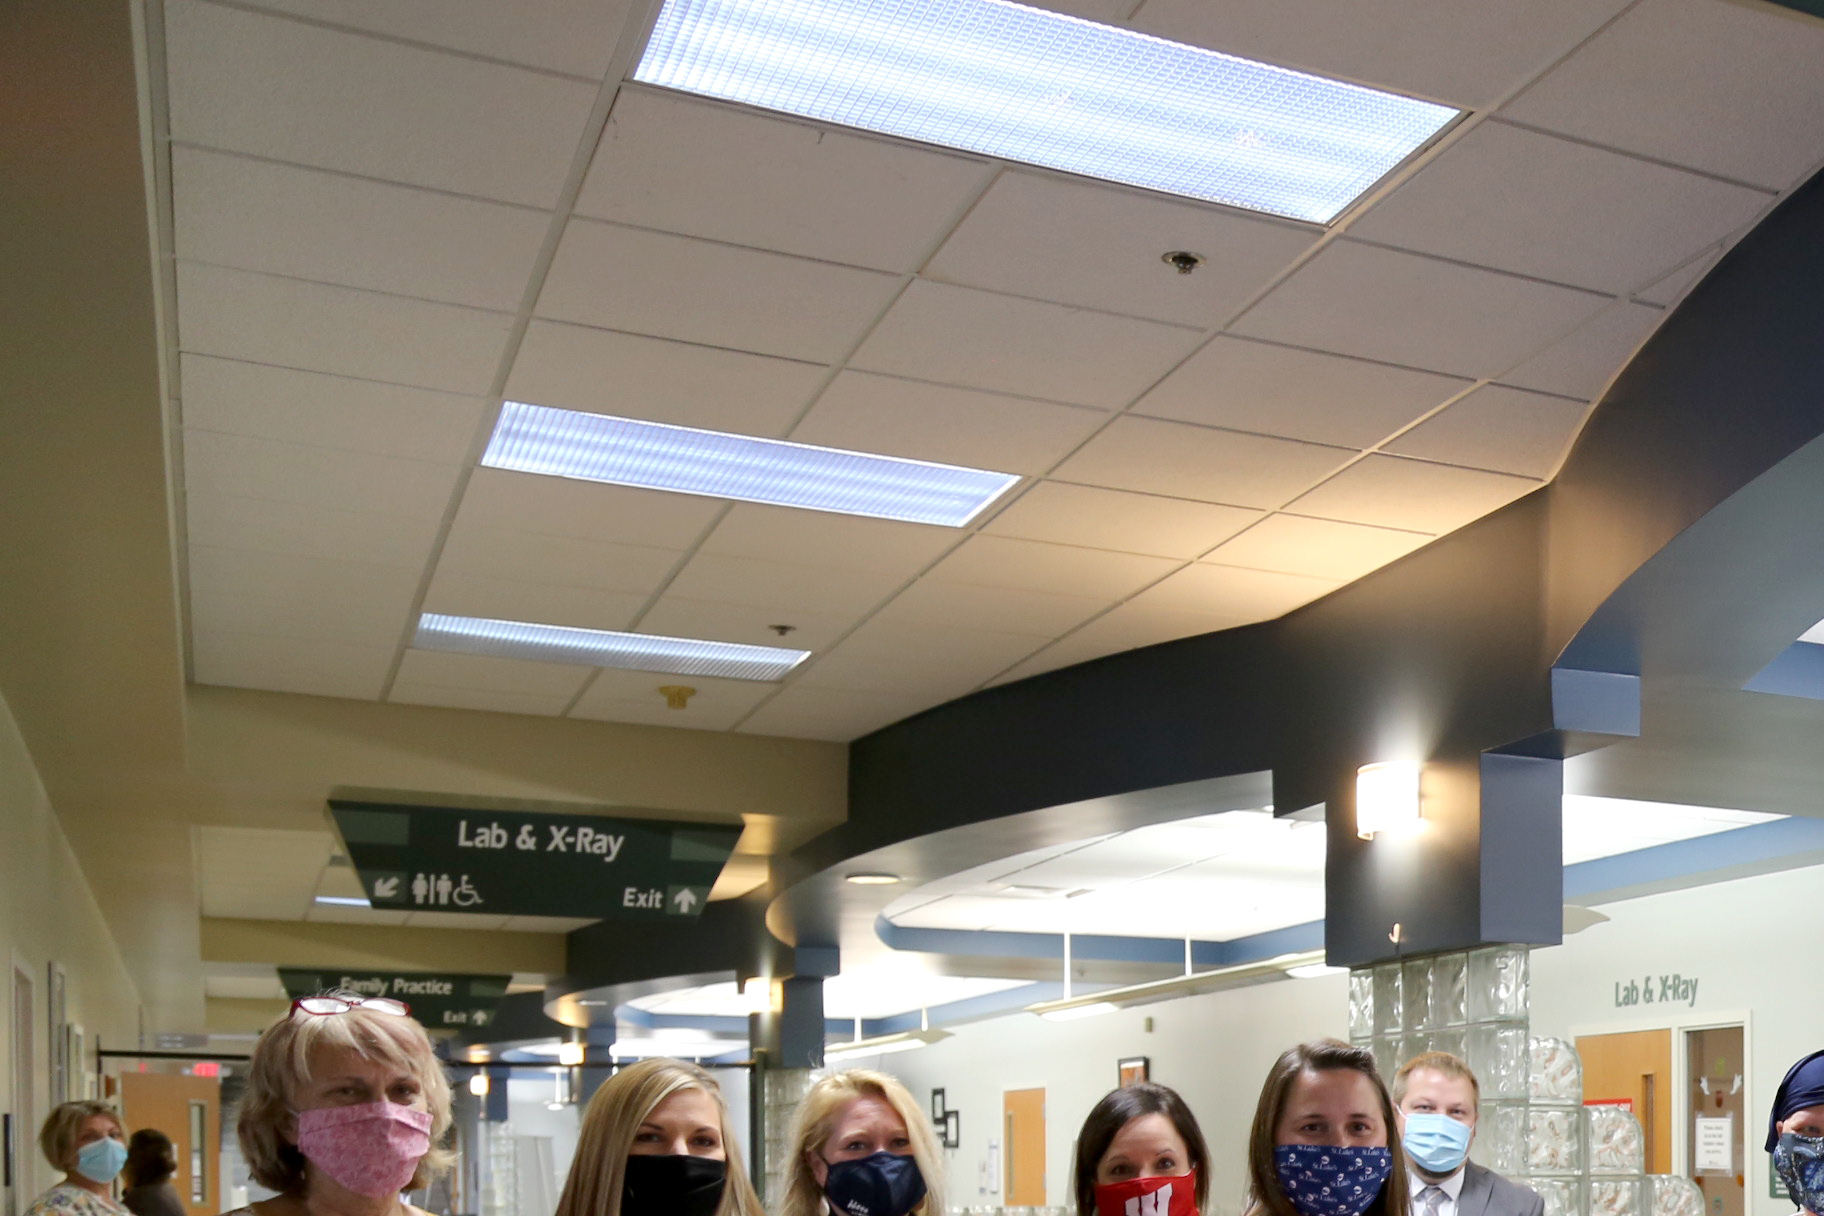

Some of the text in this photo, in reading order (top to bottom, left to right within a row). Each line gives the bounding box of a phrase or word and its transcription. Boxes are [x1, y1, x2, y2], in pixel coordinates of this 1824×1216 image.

[458, 820, 625, 862] Lab & X-Ray
[622, 887, 664, 910] Exit
[340, 976, 453, 996] Family Practice
[1614, 974, 1698, 1008] Lab & X-Ray
[443, 1010, 467, 1024] Exit
